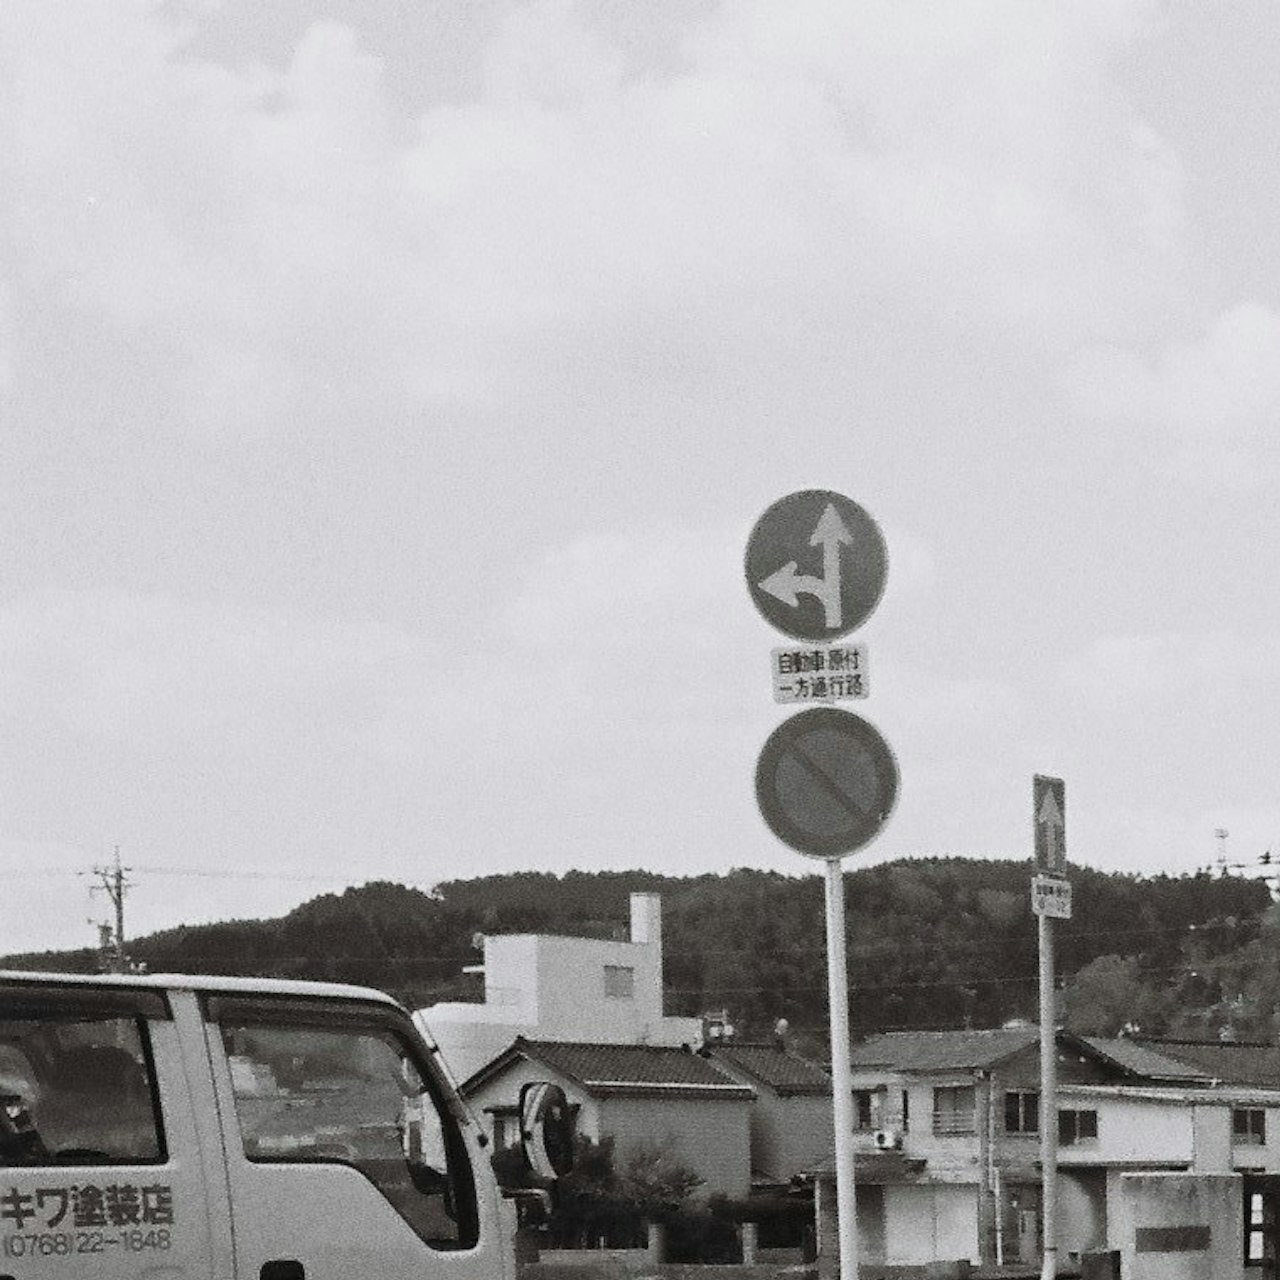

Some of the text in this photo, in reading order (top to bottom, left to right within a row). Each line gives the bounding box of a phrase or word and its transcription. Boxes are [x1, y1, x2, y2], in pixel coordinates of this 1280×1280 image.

[779, 673, 863, 698] 一方通行路
[1, 1183, 175, 1229] キワ塗装店
